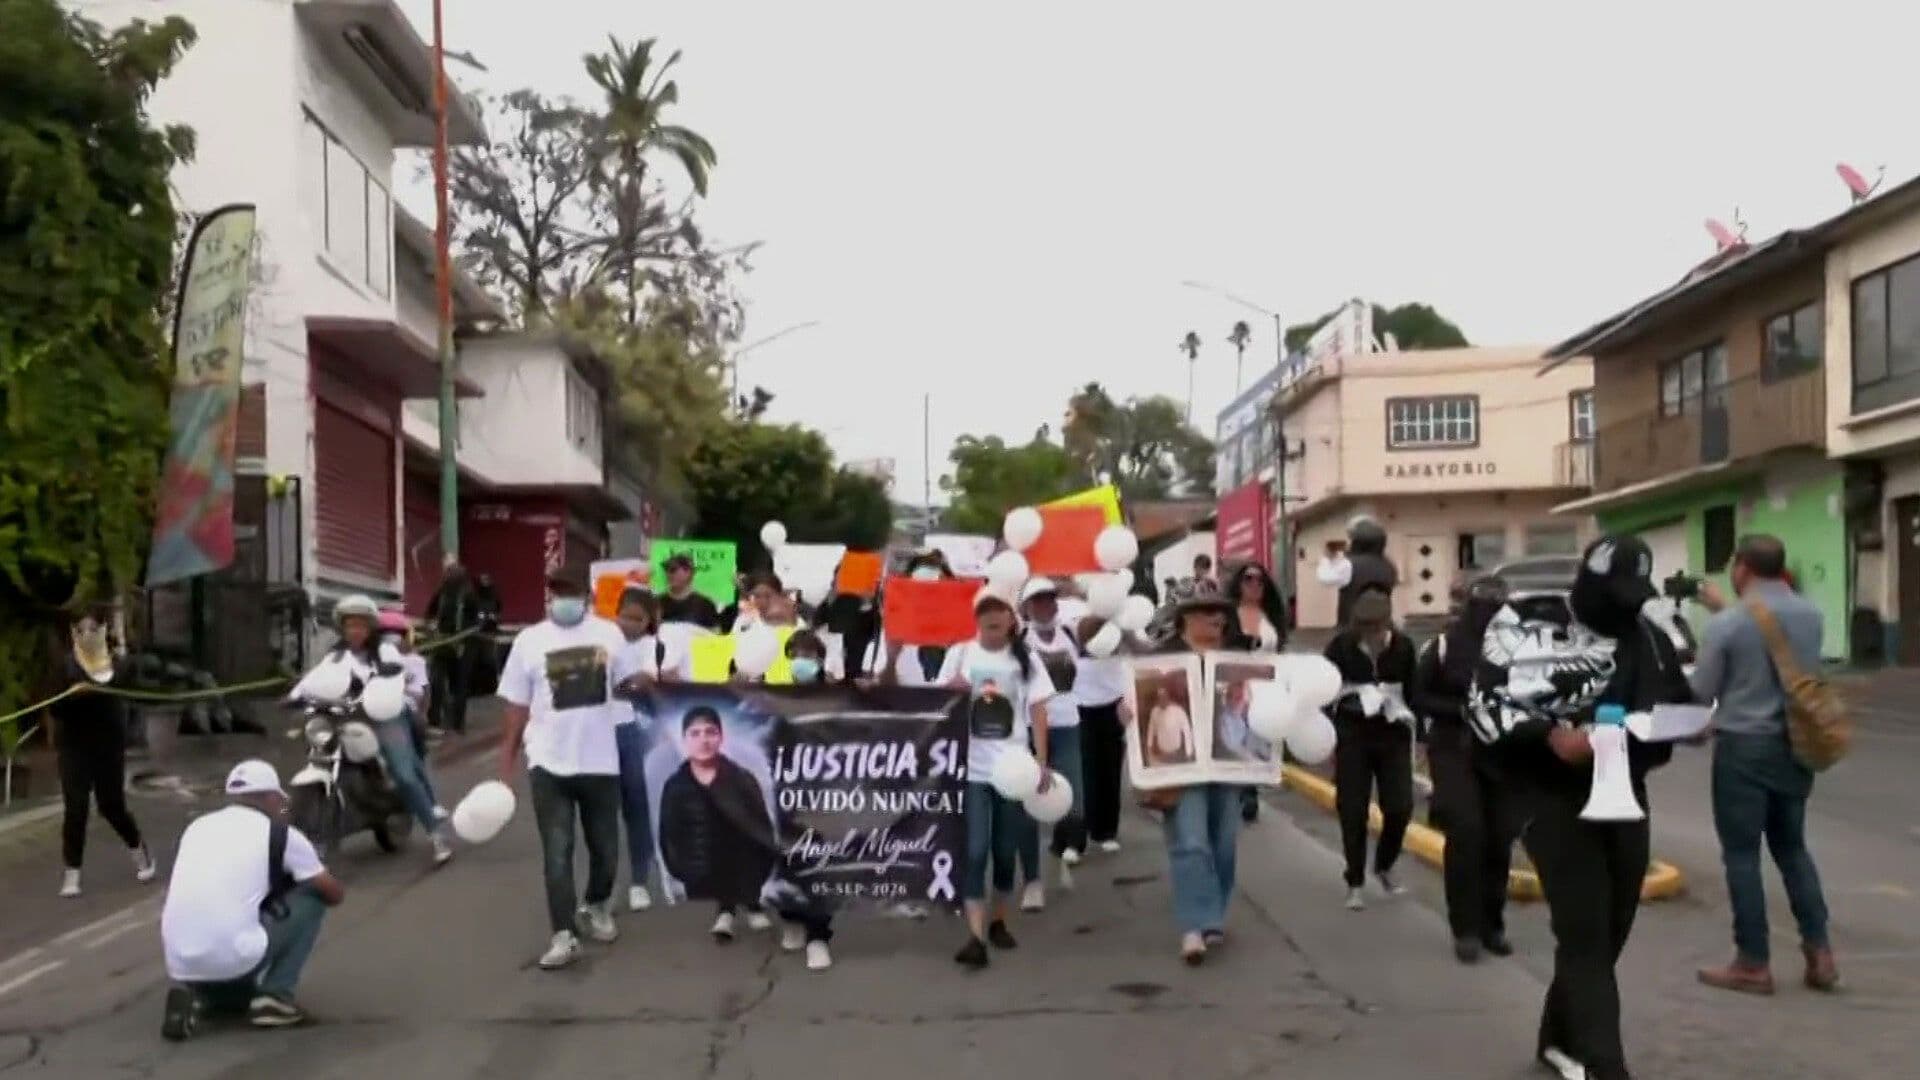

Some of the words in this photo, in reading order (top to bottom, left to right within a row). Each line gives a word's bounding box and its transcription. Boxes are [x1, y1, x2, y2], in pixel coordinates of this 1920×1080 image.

[774, 741, 917, 782] ¡JUSTICIA
[928, 738, 965, 781] SI,
[779, 785, 864, 812] OLVIDÓ
[857, 824, 935, 868] Miguel
